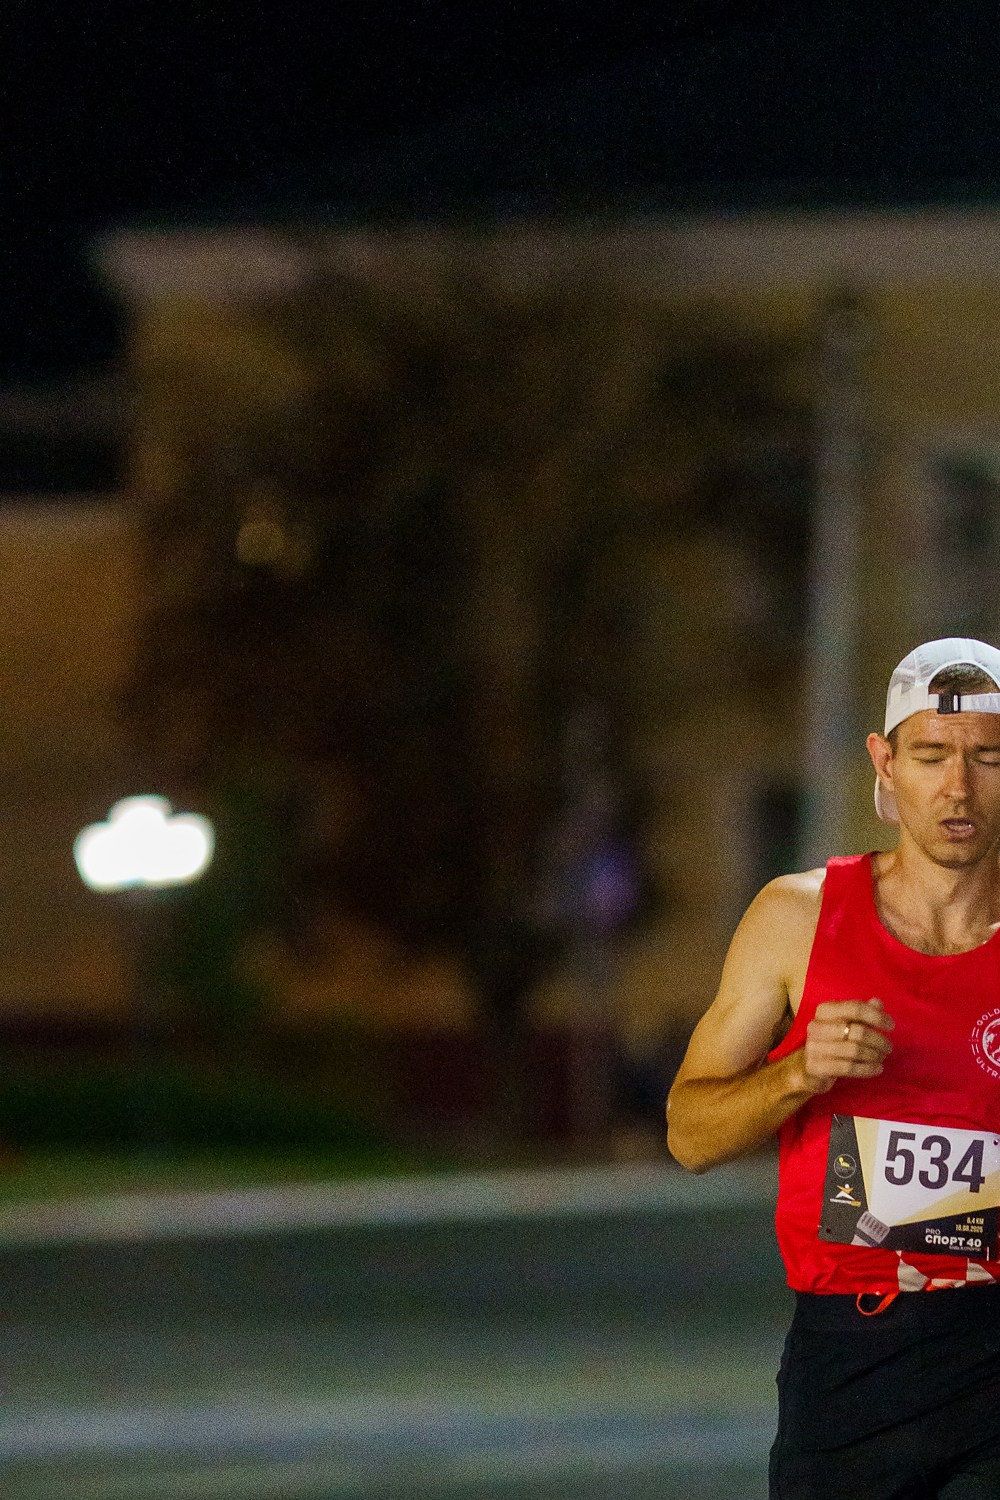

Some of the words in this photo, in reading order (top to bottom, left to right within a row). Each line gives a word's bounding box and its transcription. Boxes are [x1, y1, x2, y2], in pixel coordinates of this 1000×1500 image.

[884, 1130, 986, 1193] 534
[925, 1234, 966, 1246] СПОРТ
[966, 1238, 982, 1248] 40
